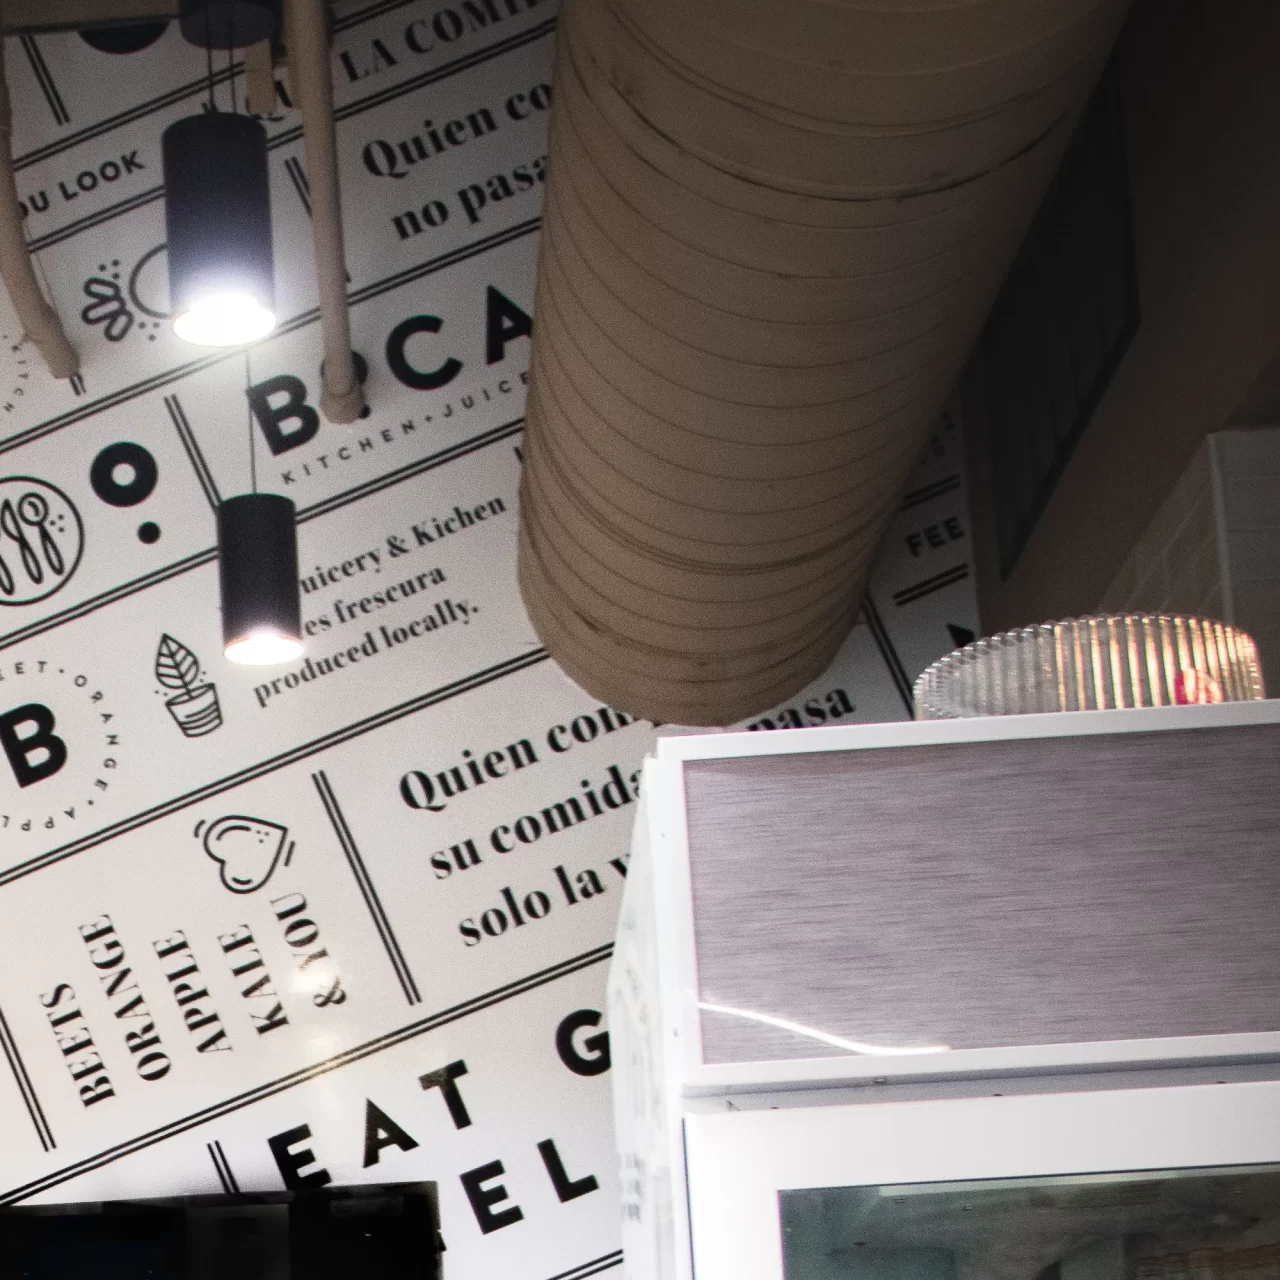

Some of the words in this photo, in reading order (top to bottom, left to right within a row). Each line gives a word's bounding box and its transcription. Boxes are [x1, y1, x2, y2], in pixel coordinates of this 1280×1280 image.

[340, 39, 398, 83] LA
[58, 150, 144, 201] LOOK
[362, 107, 499, 179] Quien
[392, 201, 449, 240] no
[246, 284, 534, 456] BCA
[386, 534, 410, 559] &
[411, 496, 507, 549] Kichen
[333, 565, 447, 628] frescura
[253, 628, 379, 708] produced
[379, 598, 480, 648] locally.
[73, 673, 121, 792] ORANGE
[399, 736, 539, 813] Quien
[429, 838, 483, 881] su
[270, 892, 331, 973] YOU
[458, 886, 552, 949] solo
[554, 864, 606, 907] la
[77, 913, 172, 1082] ORANGE
[151, 929, 233, 1054] APPLE
[217, 923, 291, 1036] KALE
[313, 974, 348, 1009] &
[38, 982, 119, 1109] BEETS
[267, 1059, 473, 1189] EAT
